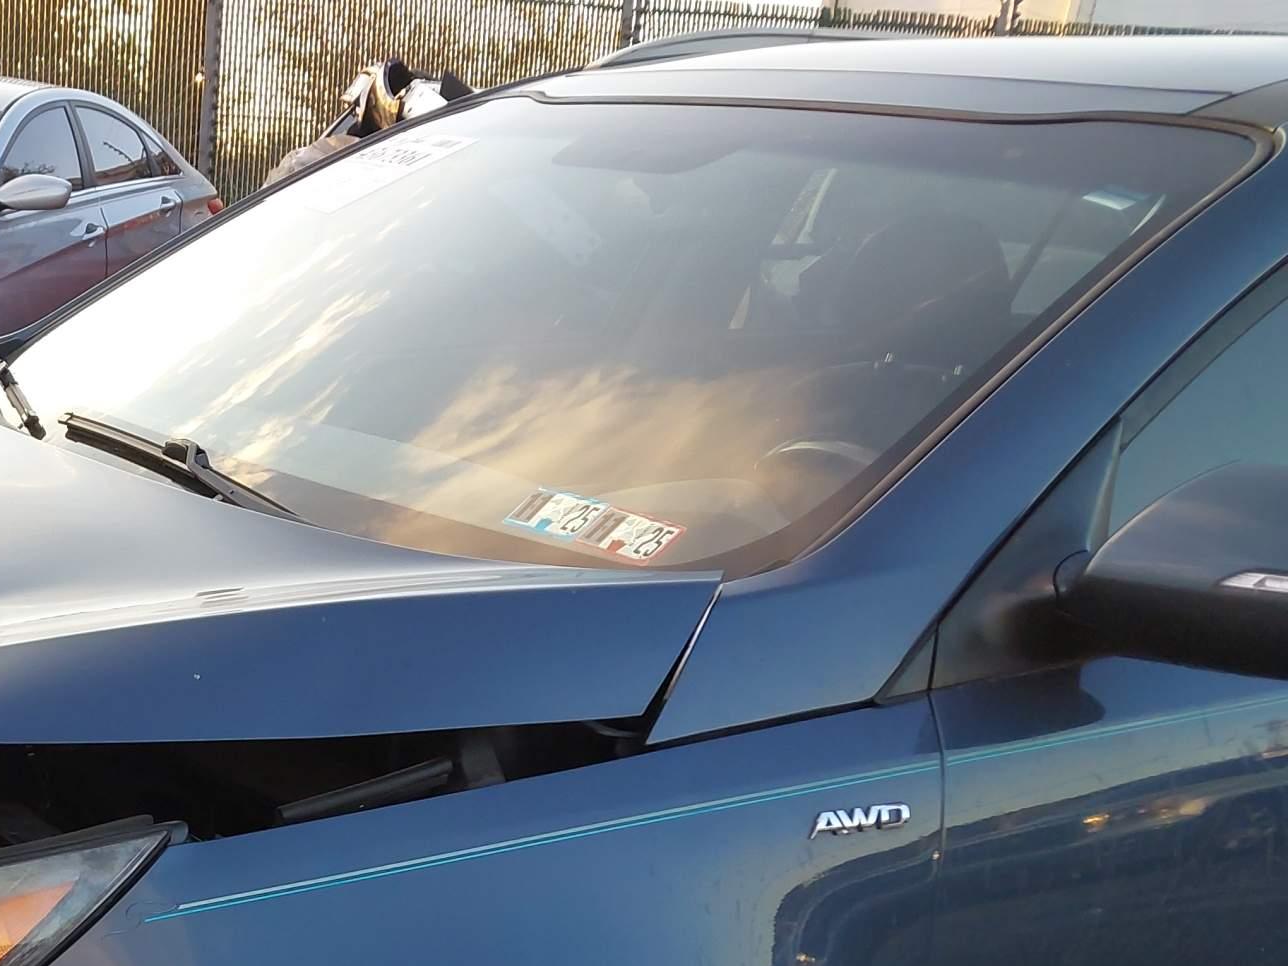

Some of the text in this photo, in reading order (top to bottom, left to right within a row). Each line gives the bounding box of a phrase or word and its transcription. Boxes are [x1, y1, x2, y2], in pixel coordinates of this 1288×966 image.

[560, 504, 599, 534] 25
[633, 527, 674, 557] 25
[810, 802, 911, 839] AWD
